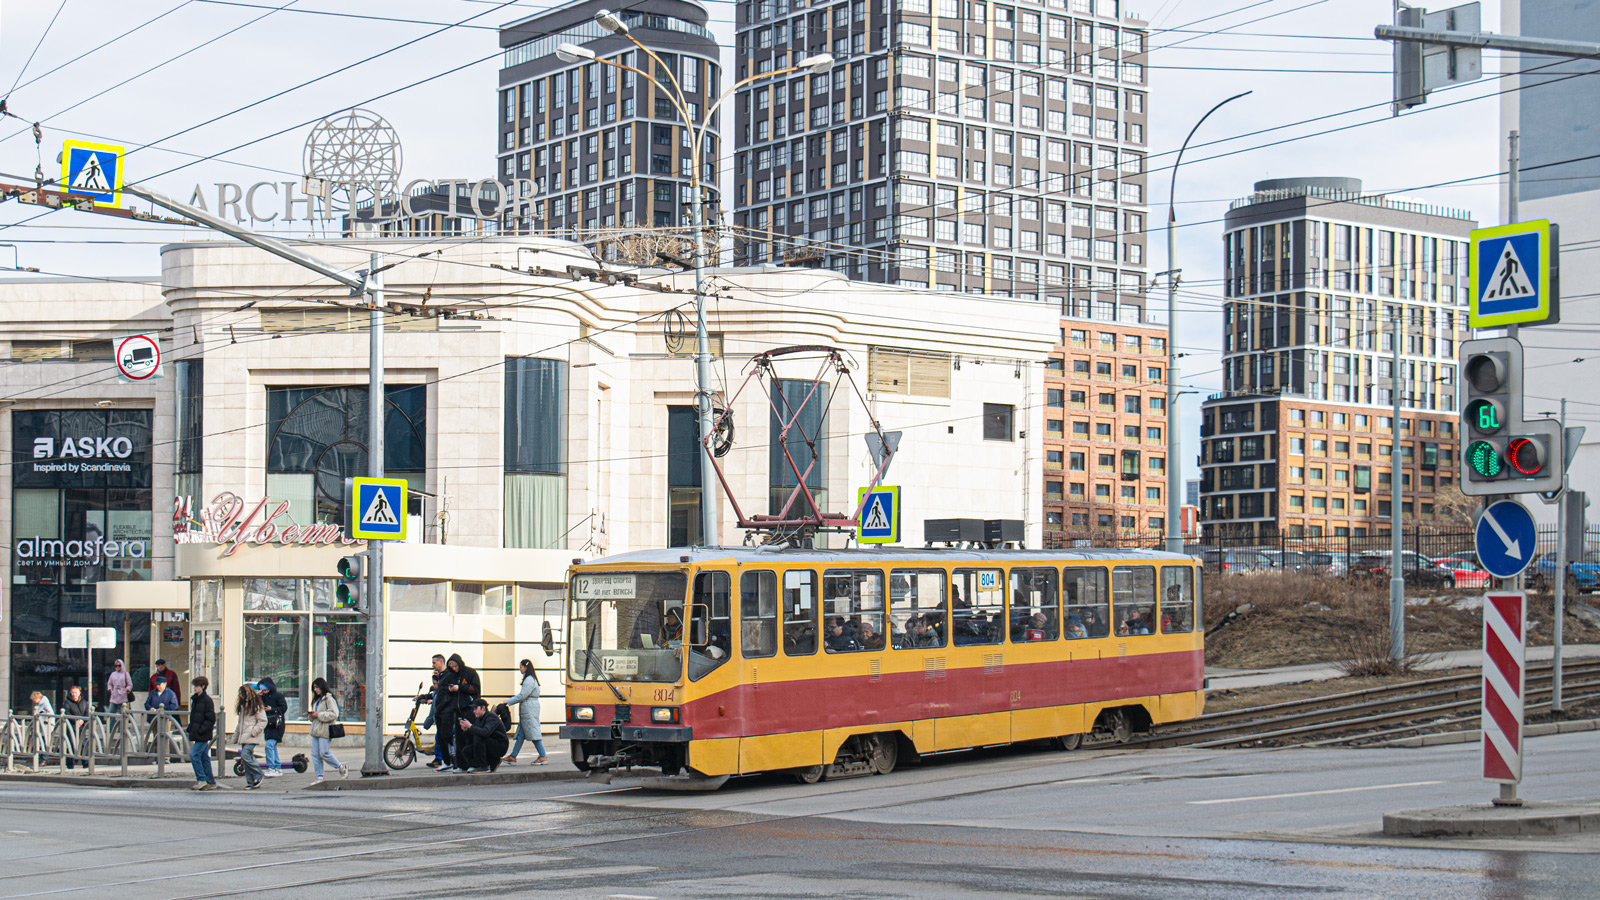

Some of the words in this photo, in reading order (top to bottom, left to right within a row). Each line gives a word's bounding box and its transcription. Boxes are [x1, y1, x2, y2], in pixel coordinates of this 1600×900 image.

[184, 178, 540, 222] ARCHITECTOR
[60, 436, 133, 458] ASKO
[33, 463, 67, 473] Inspired
[68, 463, 79, 473] by
[80, 463, 131, 472] Scandinavia
[211, 491, 369, 556] Цвет
[16, 535, 147, 565] almasfera
[45, 558, 71, 568] умный
[981, 573, 995, 586] 804
[578, 580, 589, 594] 12
[603, 659, 615, 671] 12
[653, 688, 675, 702] 804
